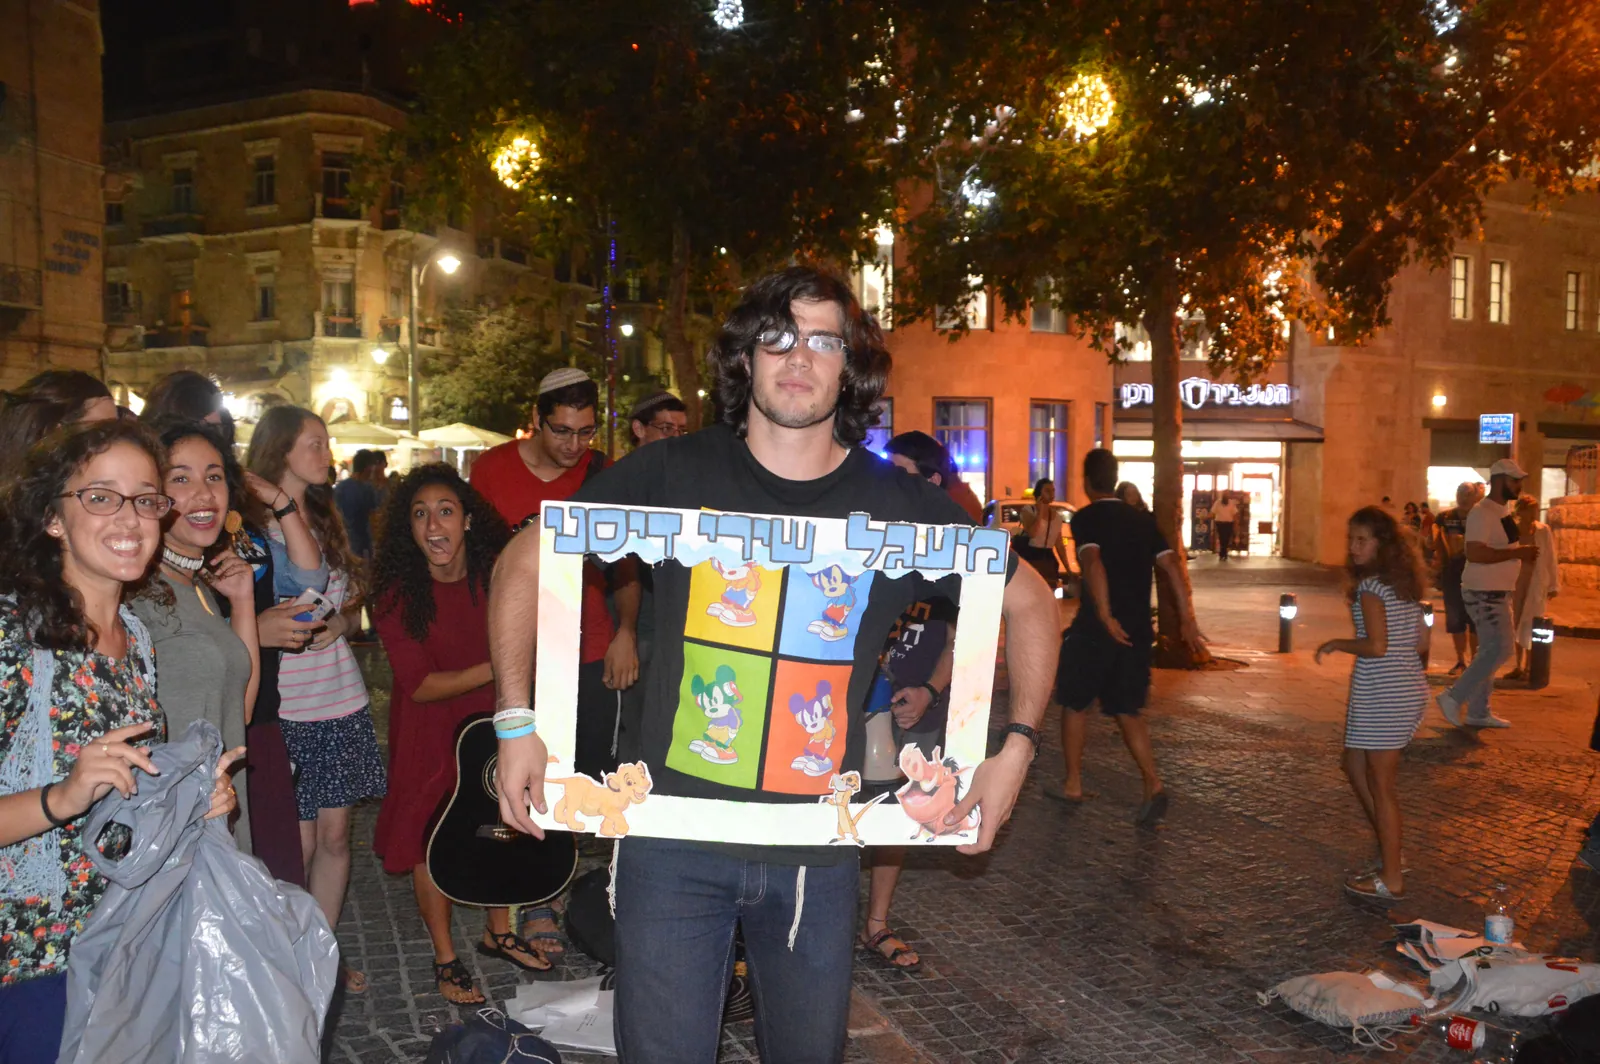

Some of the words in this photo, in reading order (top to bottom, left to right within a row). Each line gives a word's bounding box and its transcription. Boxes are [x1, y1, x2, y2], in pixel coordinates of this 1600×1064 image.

[1121, 383, 1154, 409] רכן
[544, 506, 683, 560] דיסני
[699, 512, 816, 564] שירי
[846, 511, 1010, 574] מעגל
